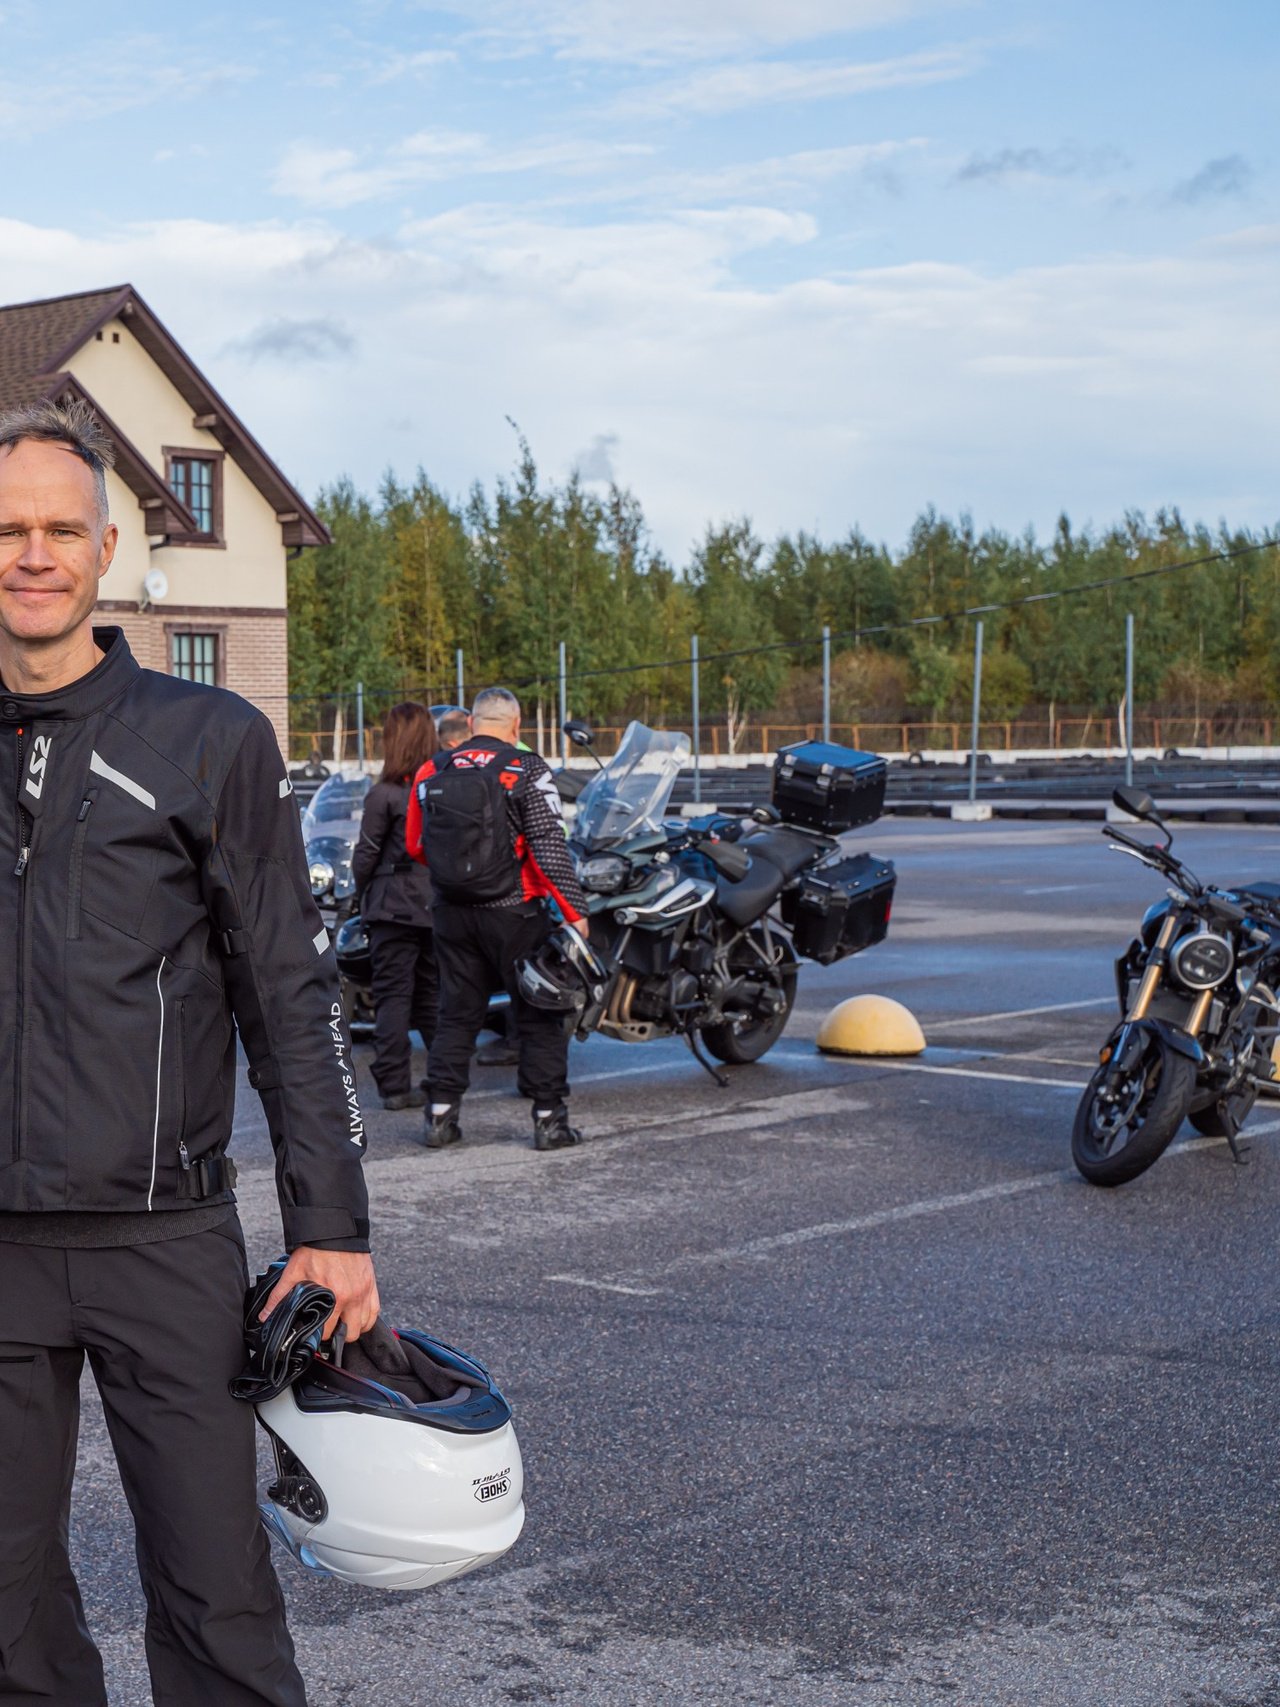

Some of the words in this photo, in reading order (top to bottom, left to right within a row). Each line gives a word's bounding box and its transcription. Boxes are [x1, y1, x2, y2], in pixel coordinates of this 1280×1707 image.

[25, 735, 52, 799] LS2
[328, 1002, 349, 1071] AHEAD
[342, 1074, 363, 1147] ALWAYS
[480, 1480, 507, 1500] SHOEI
